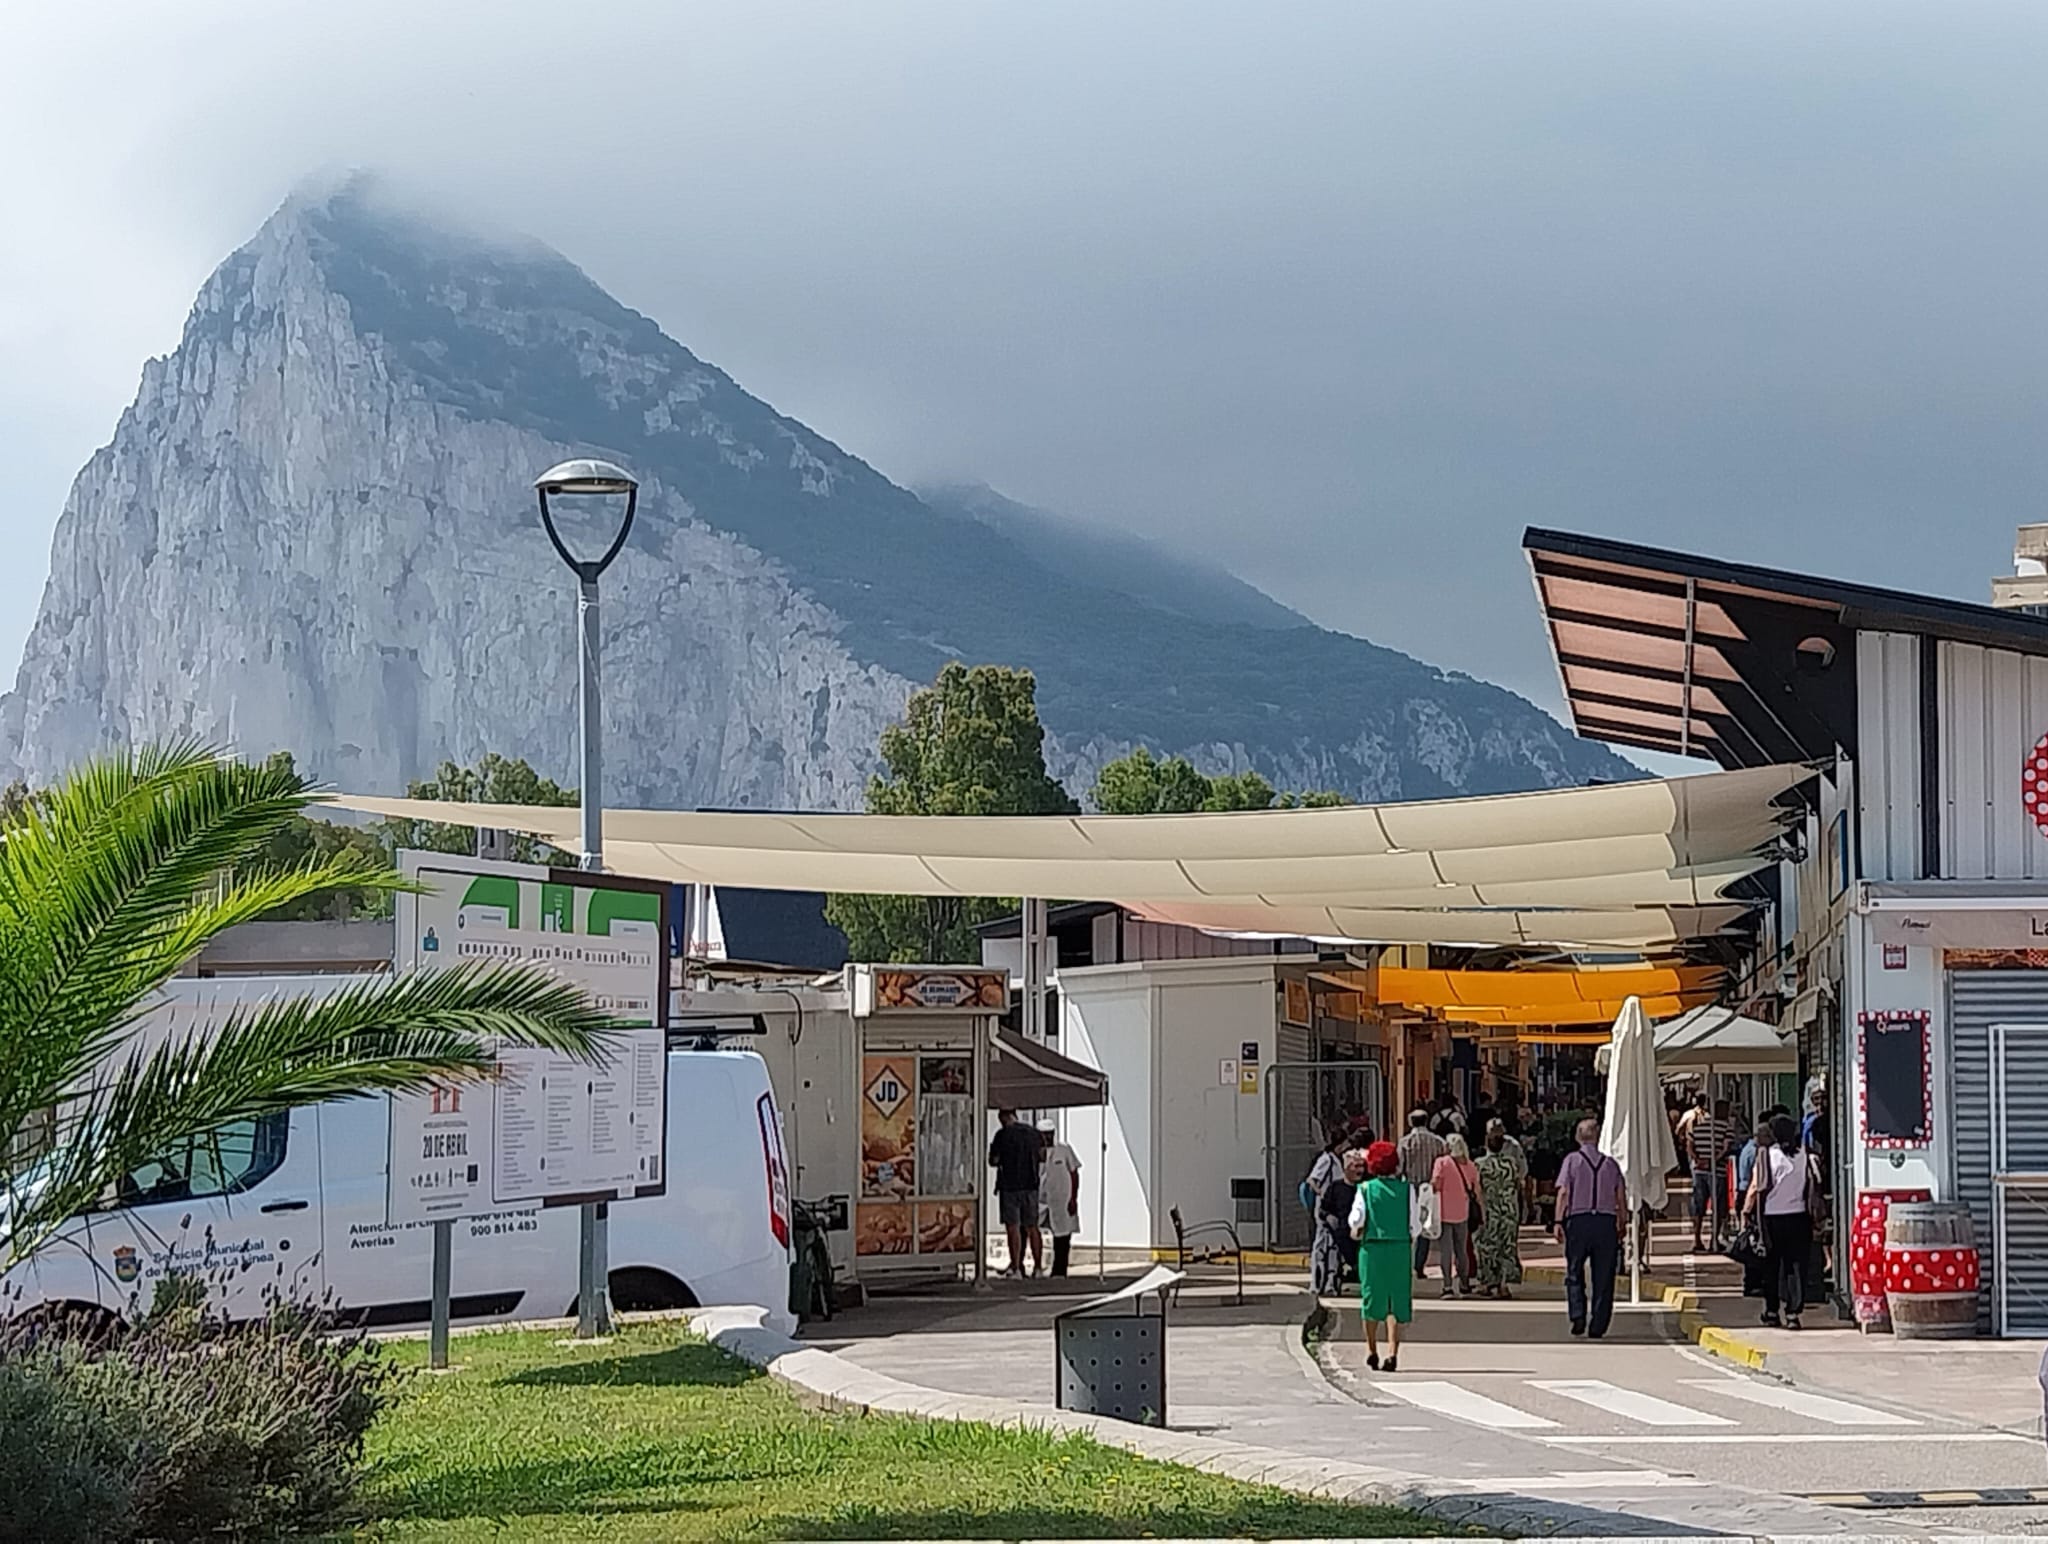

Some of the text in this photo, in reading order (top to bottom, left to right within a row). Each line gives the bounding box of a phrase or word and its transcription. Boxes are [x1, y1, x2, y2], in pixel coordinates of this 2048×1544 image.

[875, 1081, 898, 1102] JD
[423, 1133, 468, 1159] 20 DE ABRIL
[470, 1219, 538, 1237] 900 814 483
[145, 1266, 160, 1278] de
[223, 1256, 238, 1268] La
